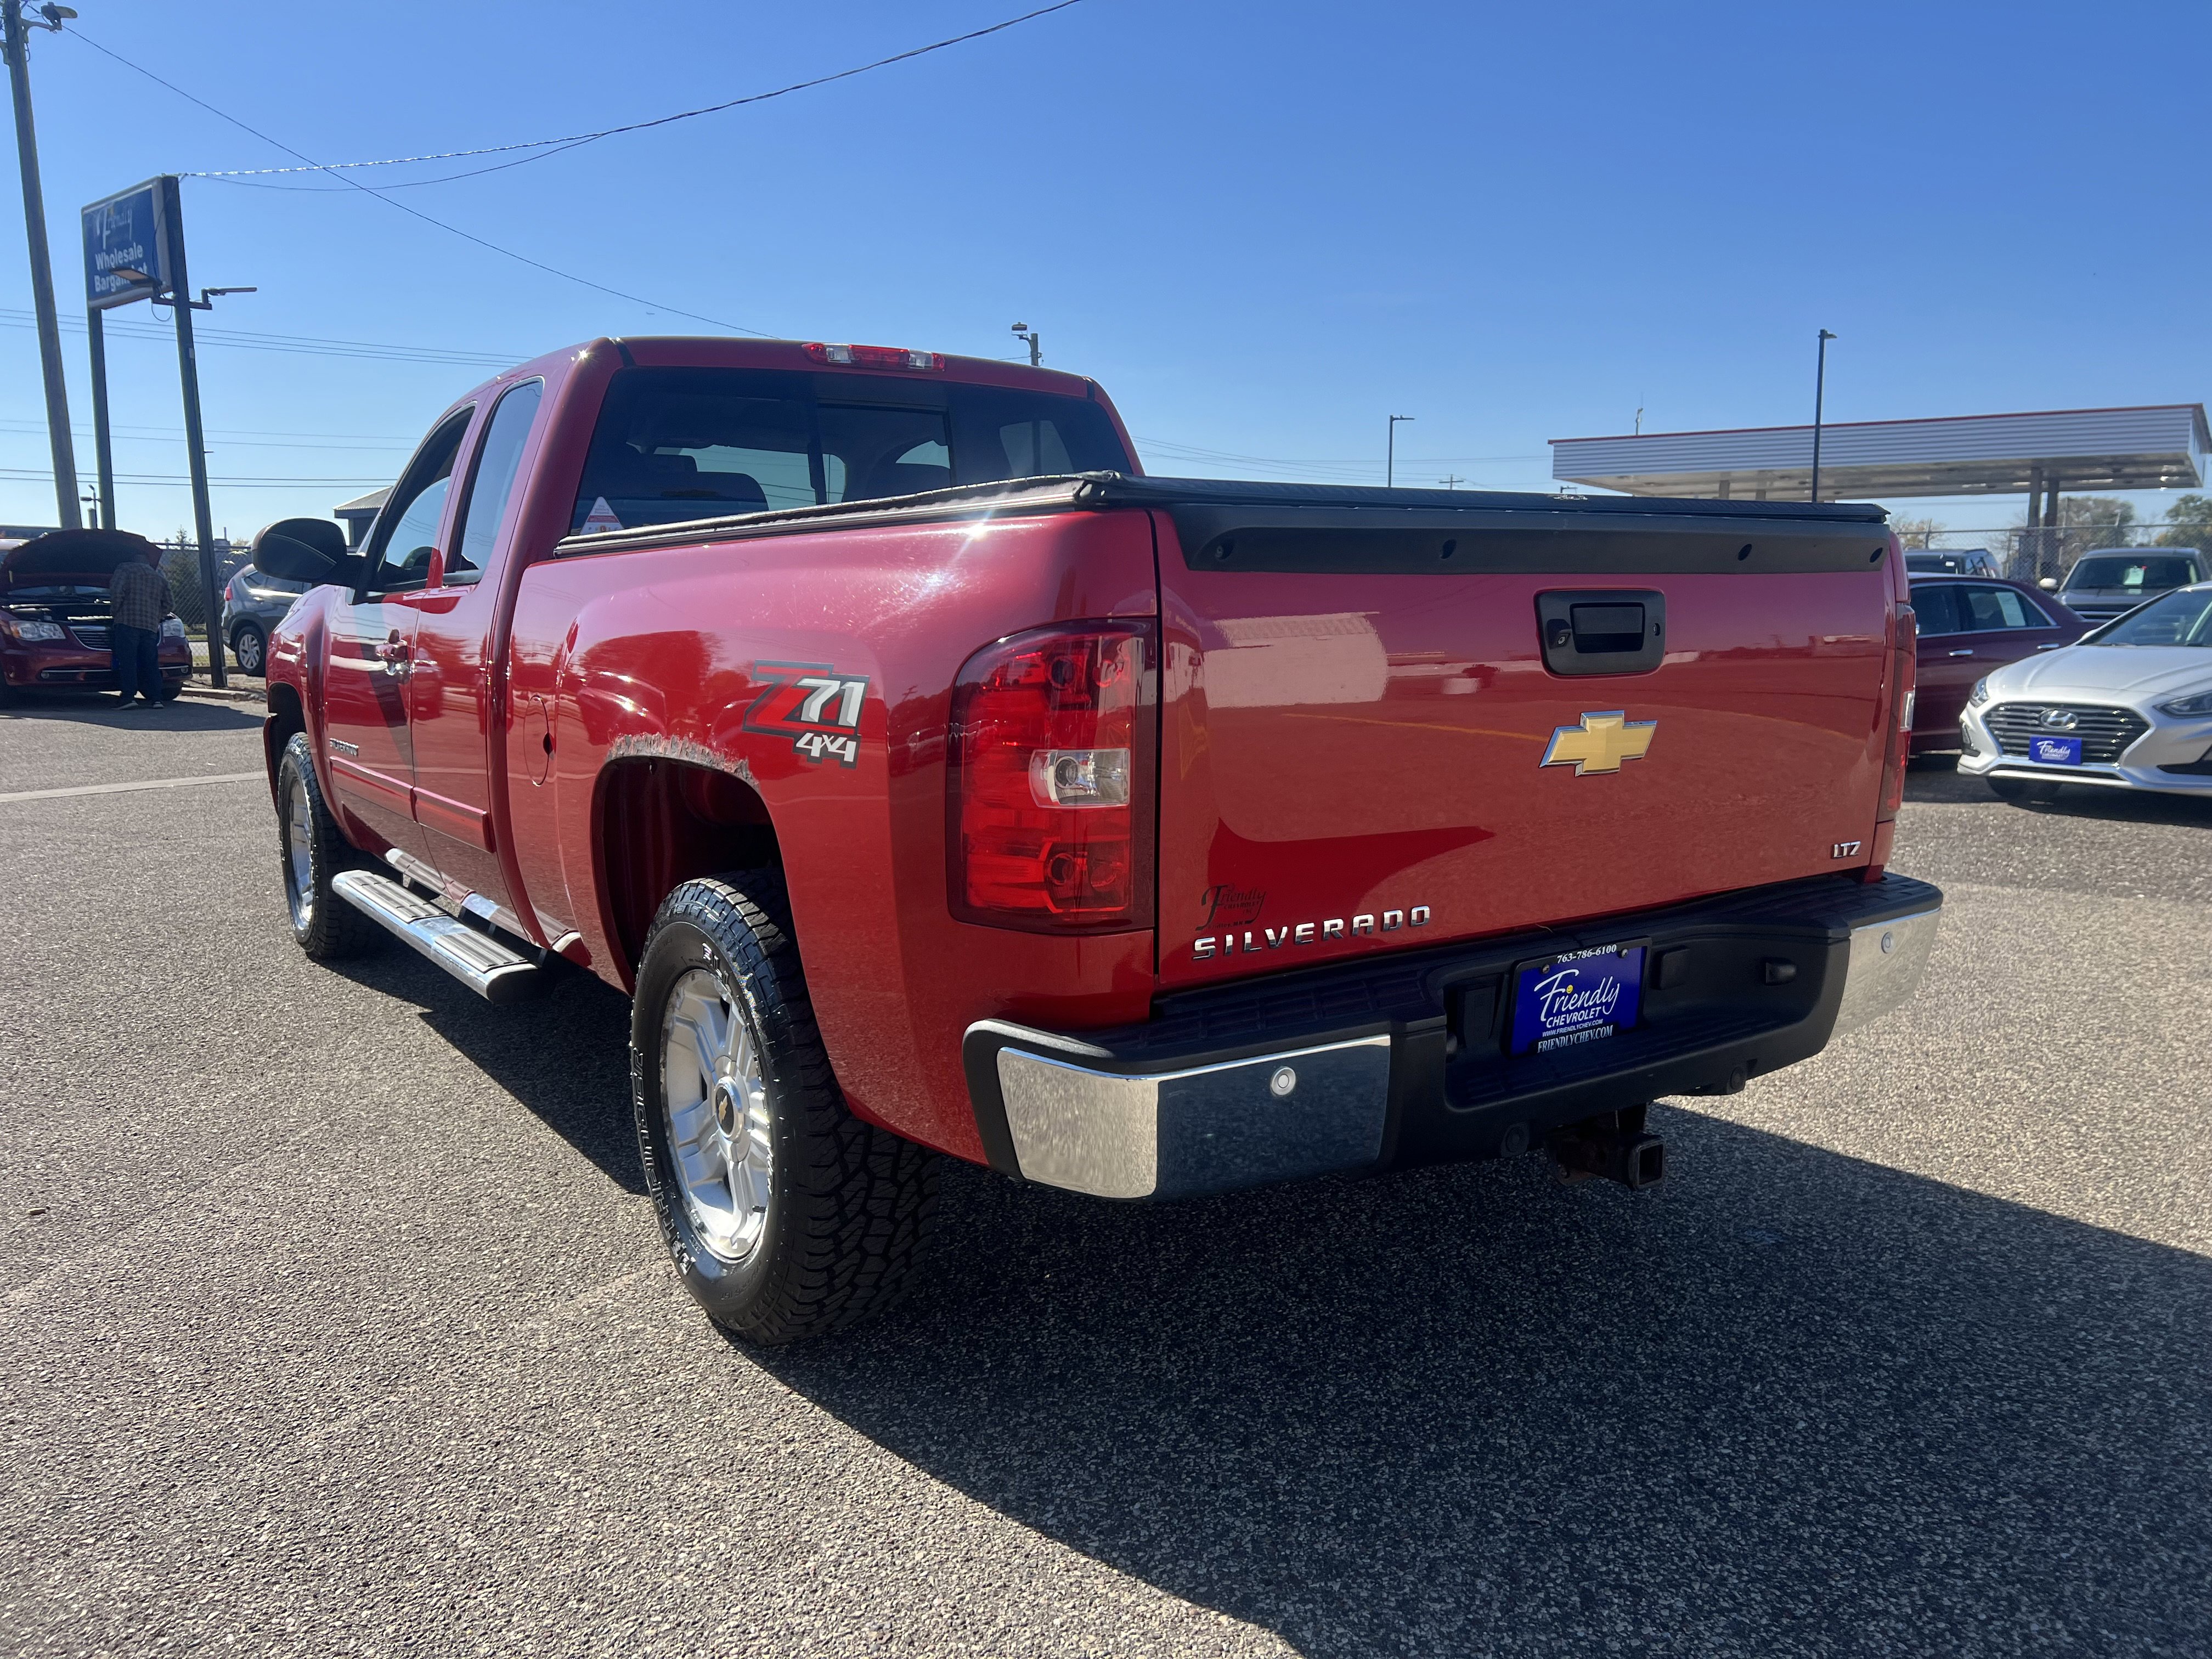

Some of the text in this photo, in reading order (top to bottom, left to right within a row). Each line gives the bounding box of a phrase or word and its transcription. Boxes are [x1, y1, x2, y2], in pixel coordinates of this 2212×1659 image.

[95, 241, 144, 271] Wholesale
[742, 659, 870, 736] Z71
[1833, 841, 1861, 857] LTZ
[1195, 883, 1267, 931] Friendly
[1192, 905, 1430, 960] SILVERADO
[1557, 944, 1617, 964] 763-786-6100
[1534, 969, 1620, 1022] Friendly
[1542, 1019, 1603, 1037] WWW.FRIENDLYCHEV.COM
[1546, 1006, 1601, 1028] CHEVROLET
[1537, 1025, 1613, 1053] FRIENDLYCHEV.COM
